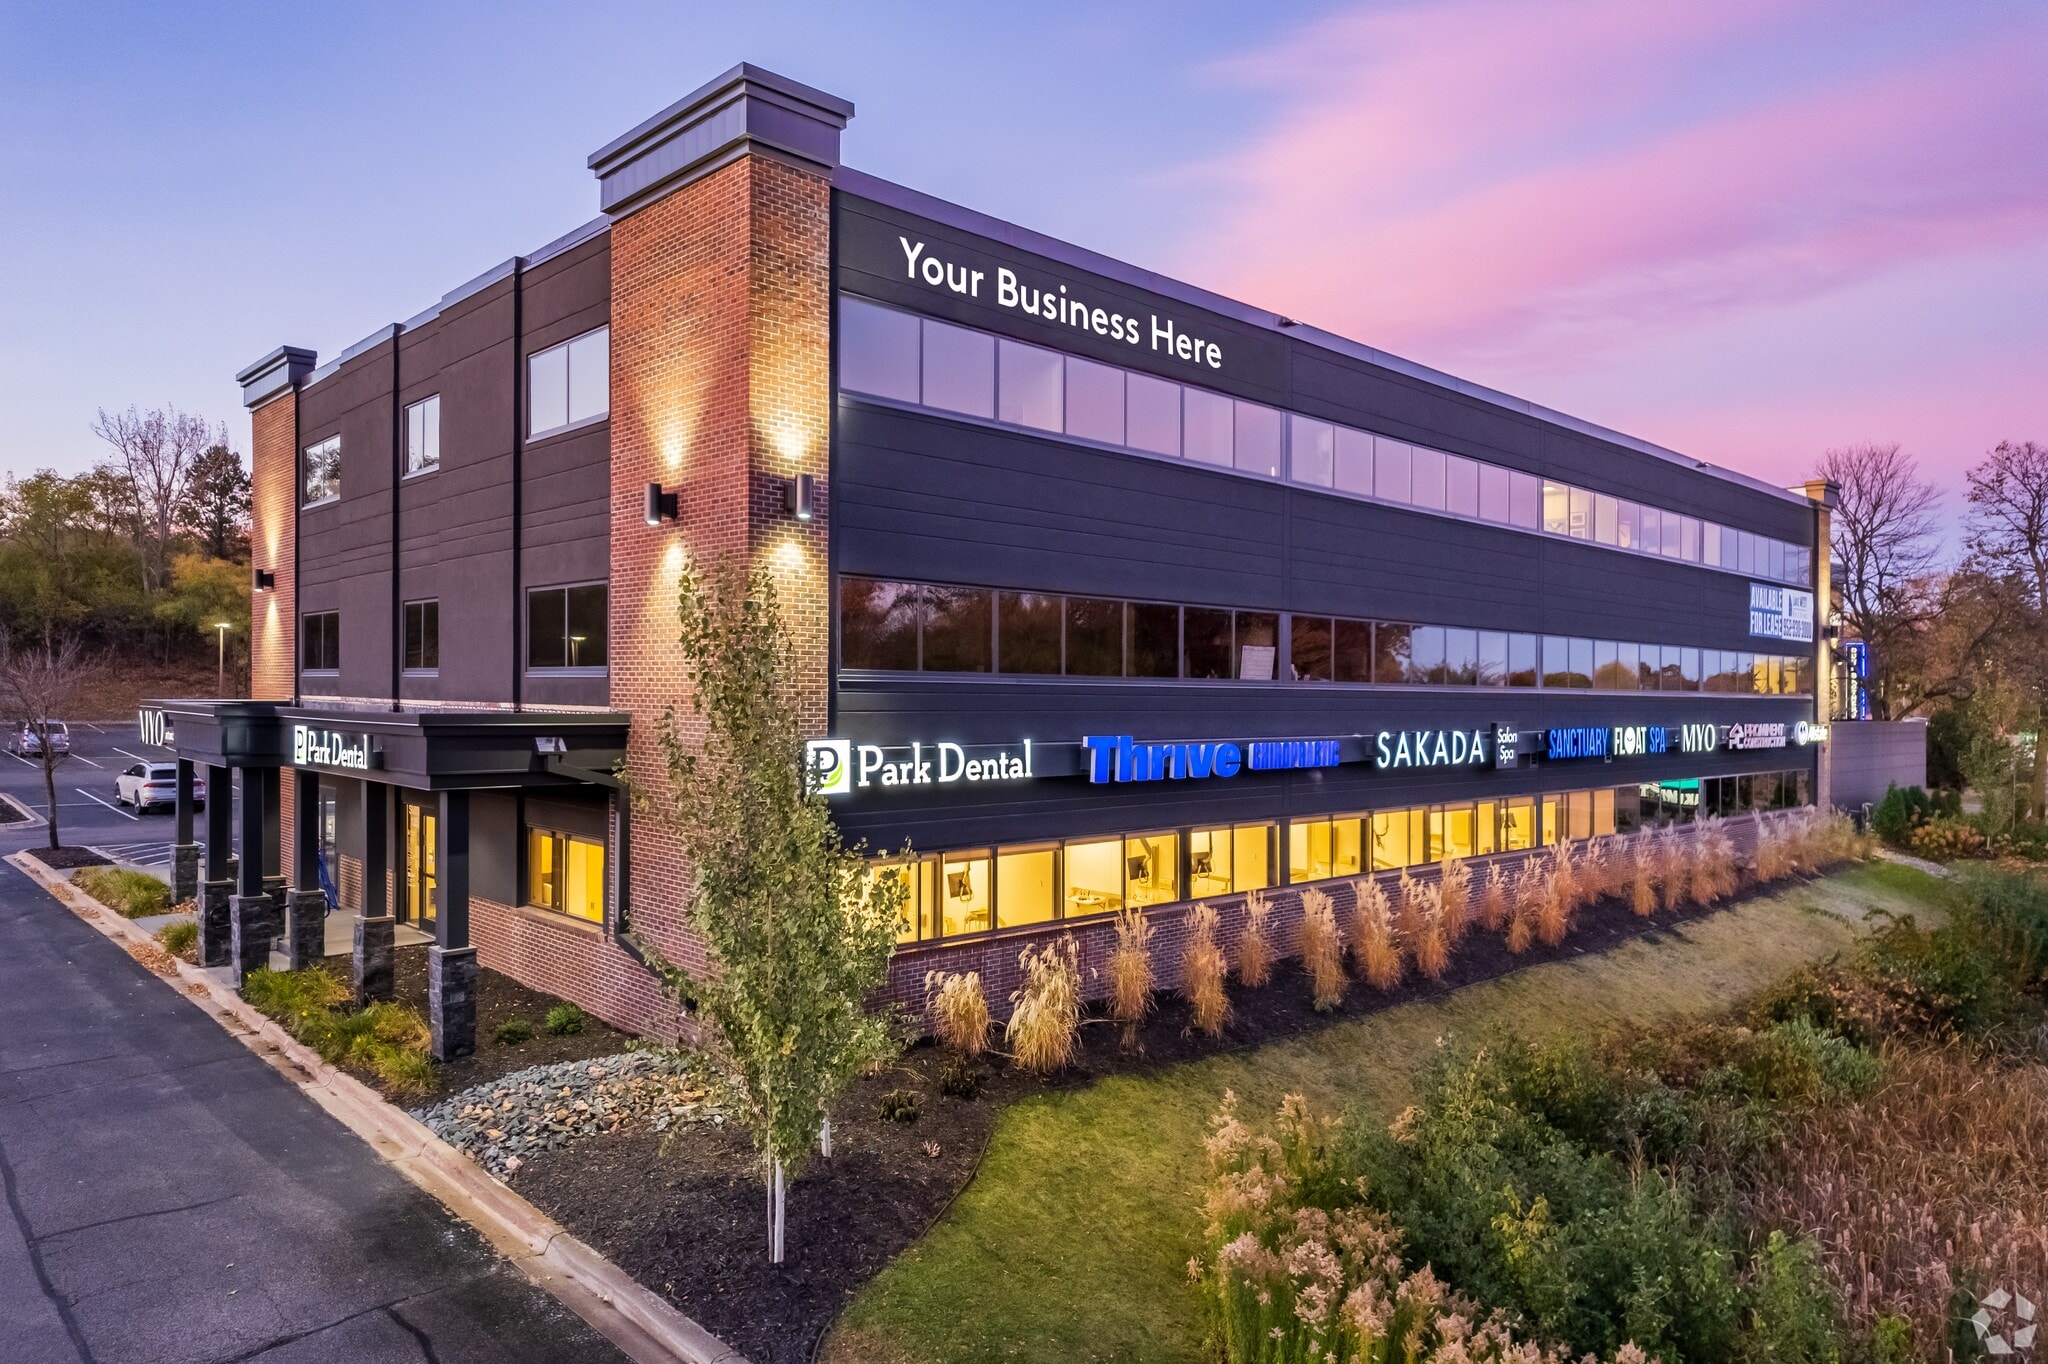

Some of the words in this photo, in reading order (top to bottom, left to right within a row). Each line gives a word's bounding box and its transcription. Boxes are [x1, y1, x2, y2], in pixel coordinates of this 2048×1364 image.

[899, 236, 984, 298] Your
[997, 267, 1140, 345] Business
[1151, 315, 1222, 369] Here
[1750, 586, 1782, 612] AVAILABLE
[1750, 611, 1762, 634] FOR
[1763, 613, 1782, 636] LEASE
[1497, 727, 1517, 743] Salon
[1550, 728, 1609, 759] SANCTUARY
[1614, 726, 1647, 756] FLOAT
[1650, 727, 1666, 752] SPA
[1682, 724, 1715, 752] MYO
[1744, 723, 1784, 737] PROMINENT
[308, 731, 330, 764] Park
[332, 733, 367, 769] Dental
[857, 742, 931, 787] Park
[938, 739, 1032, 782] Dental
[1083, 736, 1241, 783] Thrive
[1248, 741, 1340, 770] CHIROPRACTIC
[1377, 730, 1485, 768] SAKADA
[1500, 745, 1514, 764] Spa
